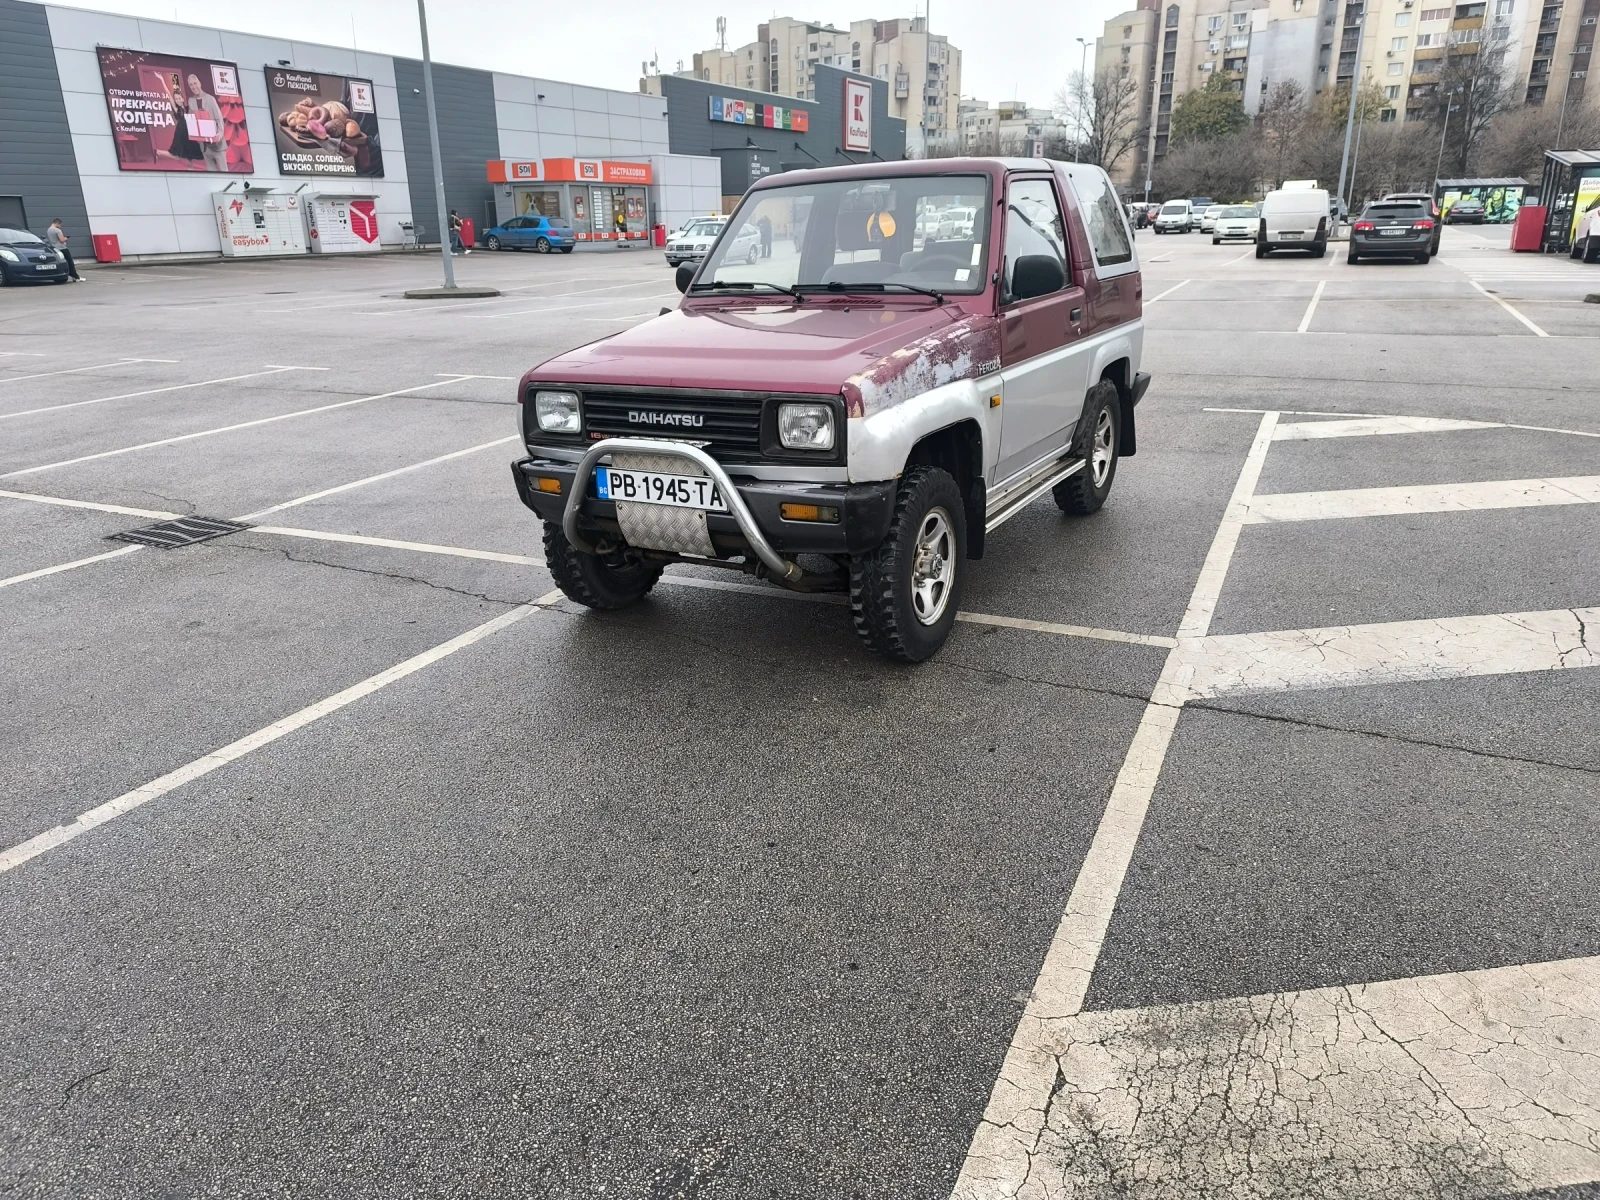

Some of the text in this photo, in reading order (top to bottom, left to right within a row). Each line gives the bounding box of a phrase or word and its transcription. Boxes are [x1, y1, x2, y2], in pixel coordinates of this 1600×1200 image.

[286, 73, 312, 83] Kaufland
[287, 81, 318, 92] пекарна
[108, 88, 135, 97] ОТВОРИ
[135, 90, 161, 99] ВРАТАТА
[111, 97, 173, 111] ПРЕКРАСНА
[854, 94, 864, 122] K
[113, 110, 175, 128] КОЛЕДА
[120, 125, 147, 133] Kaufland
[849, 125, 868, 138] Kaufland
[281, 153, 345, 163] СЛАДКО. СОЛЕНО.
[283, 163, 357, 173] ВКУСНО. ПРОВЕРЕНО.
[518, 165, 531, 173] SDI
[584, 165, 594, 173] SDI
[609, 166, 646, 177] ЗАСТРАХОВКИ
[307, 201, 316, 227] speedy
[233, 238, 265, 247] easybox
[628, 411, 704, 427] DAIHATSU
[599, 486, 608, 494] BG
